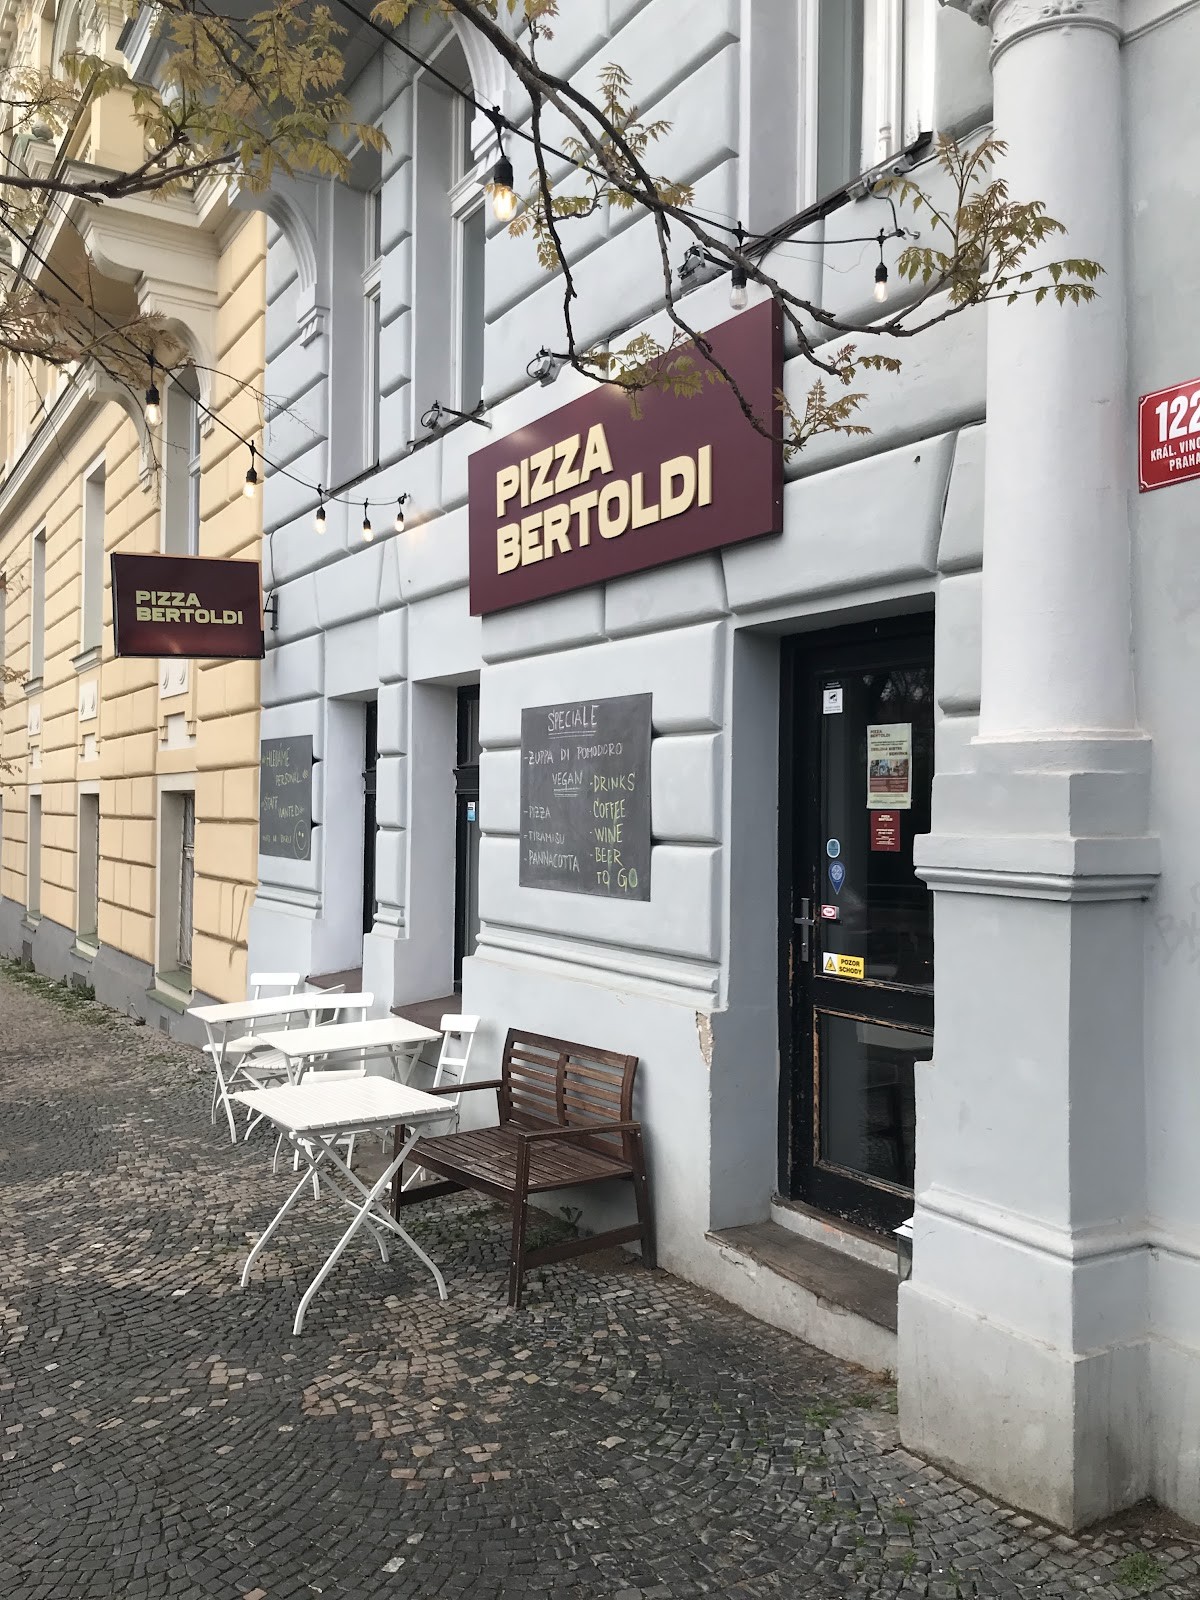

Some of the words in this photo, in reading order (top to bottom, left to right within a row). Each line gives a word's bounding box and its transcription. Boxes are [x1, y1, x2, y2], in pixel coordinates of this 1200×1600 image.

[1150, 443, 1177, 462] KRÁL.
[496, 422, 614, 518] PIZZA
[496, 444, 713, 575] BERTOLDI
[135, 590, 202, 607] PIZZA
[136, 606, 244, 625] BERTOLDI
[547, 704, 600, 732] SPECIALE
[560, 748, 570, 761] DI
[577, 742, 623, 760] POMODORO
[552, 770, 583, 789] VEGAN
[596, 869, 610, 885] TO
[617, 867, 638, 892] GO
[839, 966, 862, 975] SCHODY
[840, 958, 860, 967] POZOR
